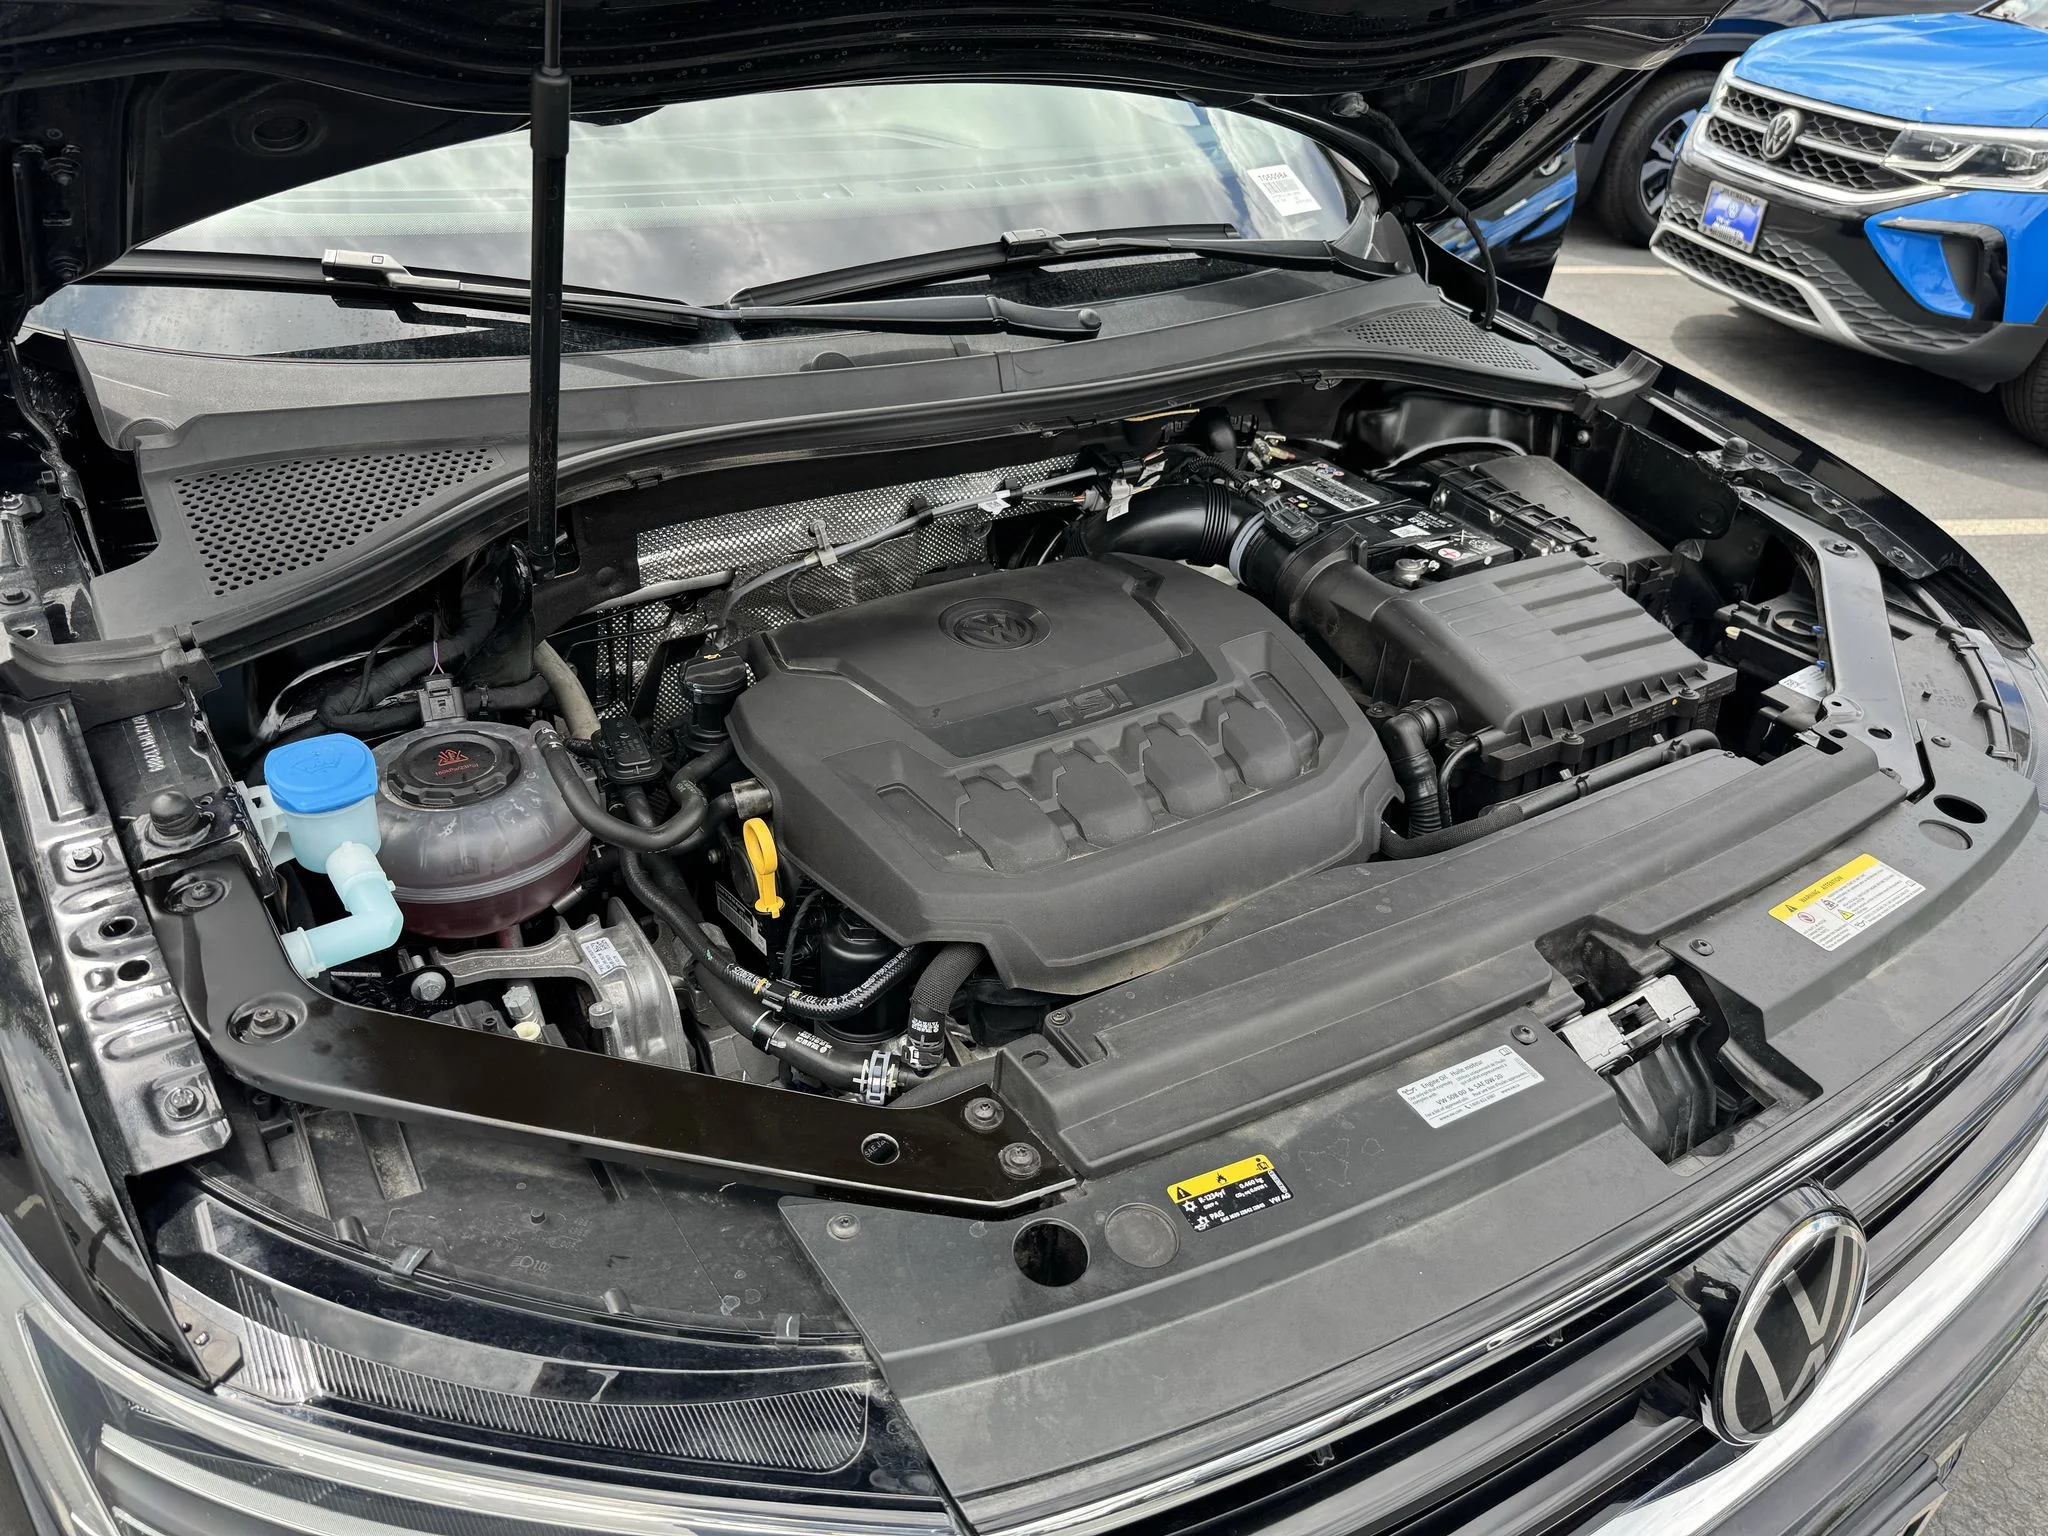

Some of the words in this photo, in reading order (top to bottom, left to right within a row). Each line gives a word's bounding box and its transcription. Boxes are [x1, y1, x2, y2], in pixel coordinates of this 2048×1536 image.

[1032, 683, 1134, 726] TSI
[1798, 889, 1821, 903] WARNING
[1819, 874, 1844, 890] ATTENTION
[1463, 1060, 1483, 1070] moteur
[1420, 1078, 1441, 1089] Engine
[1484, 1074, 1503, 1083] 0W-20
[865, 1144, 877, 1157] SAE
[1198, 1189, 1227, 1204] R-1234yf
[1239, 1180, 1255, 1188] 0.460
[1254, 1176, 1264, 1184] kg
[1209, 1210, 1224, 1219] PAG
